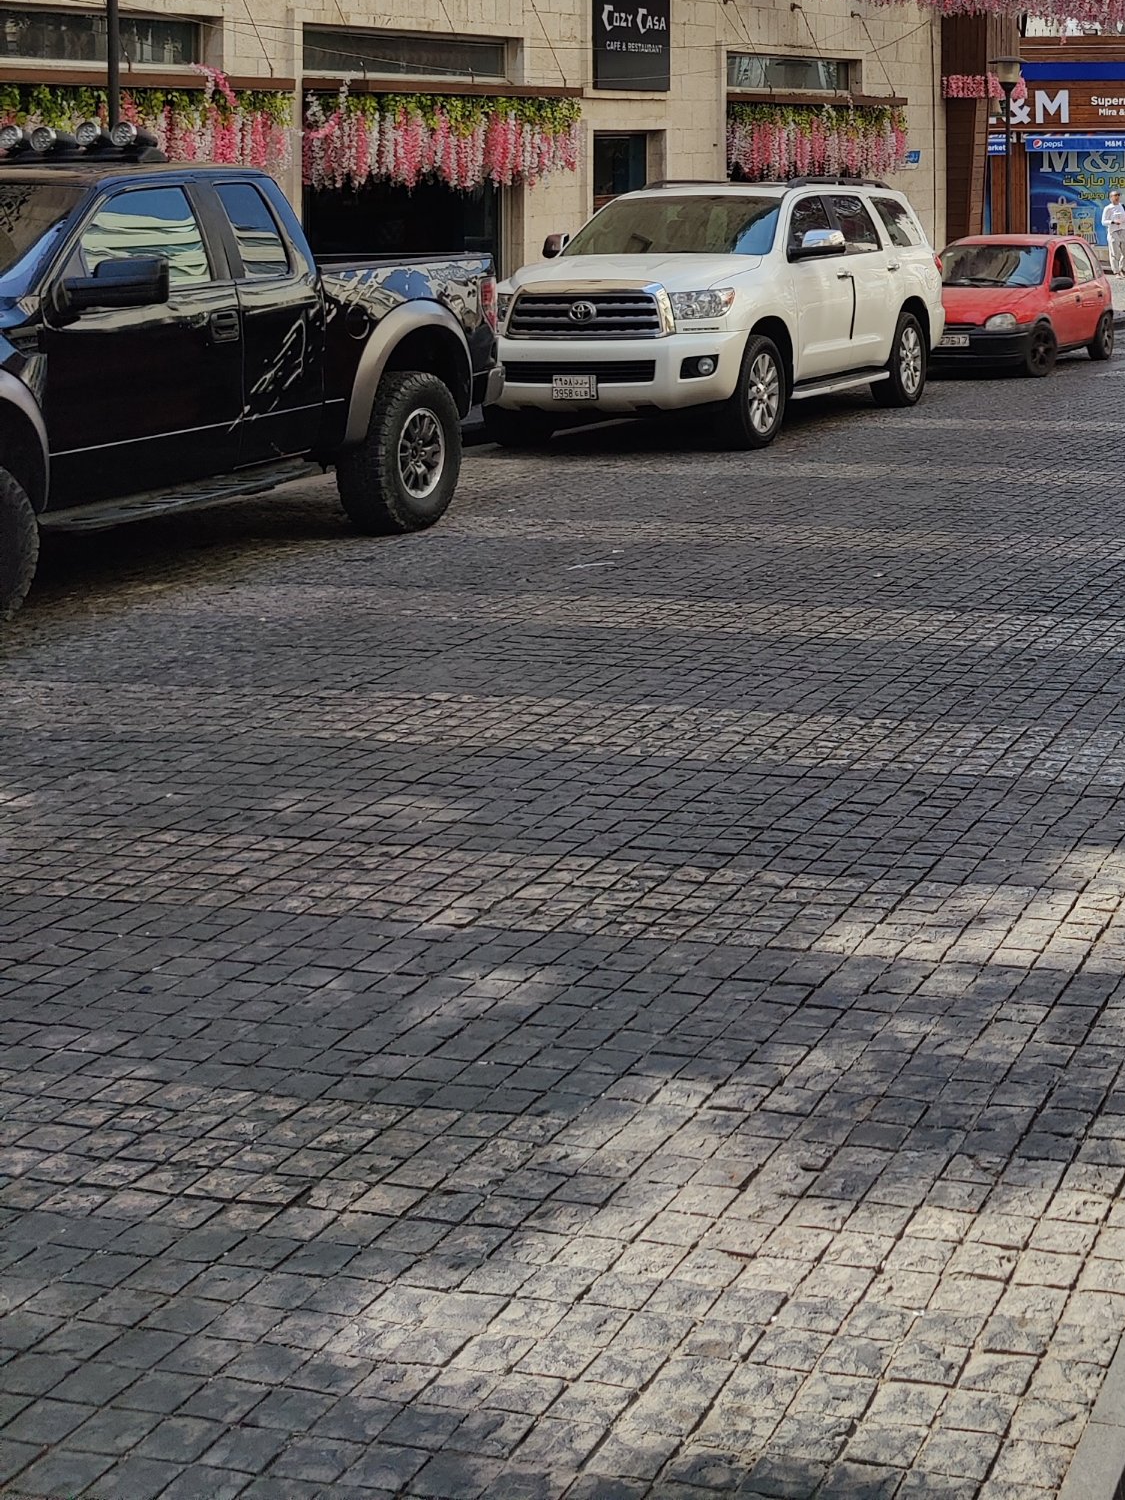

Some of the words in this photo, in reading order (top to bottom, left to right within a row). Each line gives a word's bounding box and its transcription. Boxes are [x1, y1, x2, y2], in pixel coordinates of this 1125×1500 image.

[601, 4, 633, 32] COZY
[636, 8, 667, 35] CASA
[628, 42, 663, 54] RESTAURANT
[1098, 108, 1117, 116] Mira
[1119, 108, 1125, 116] &
[1043, 140, 1064, 149] pepsi
[1062, 173, 1105, 187] ماركت
[554, 388, 573, 398] 3958
